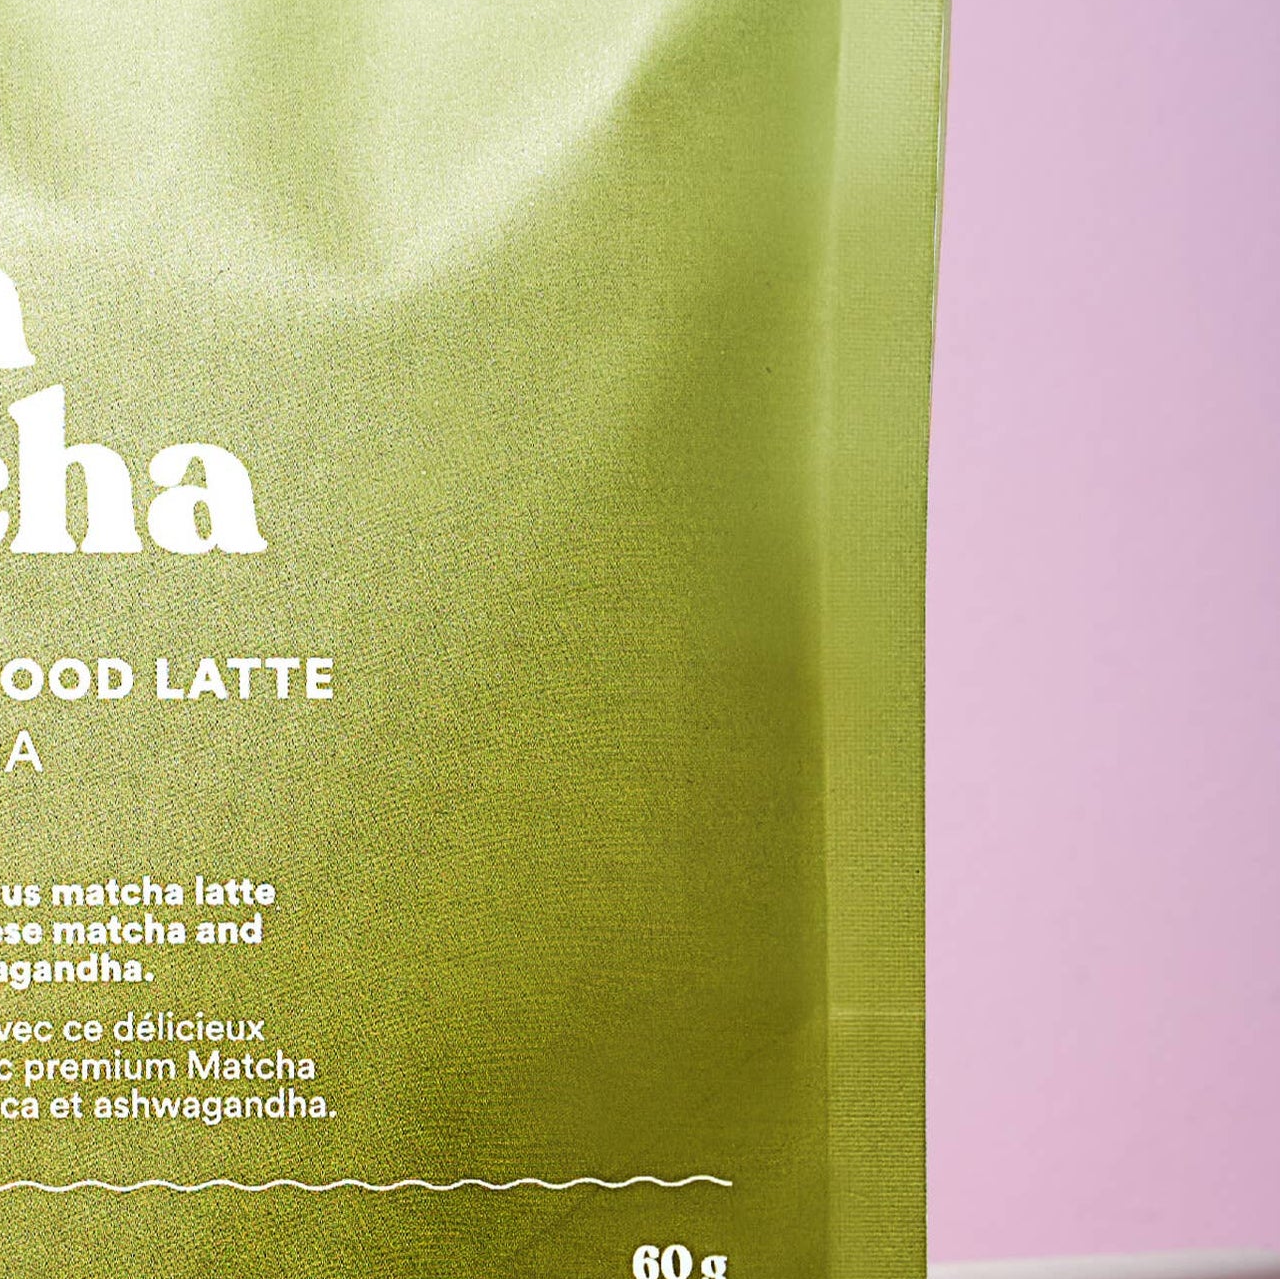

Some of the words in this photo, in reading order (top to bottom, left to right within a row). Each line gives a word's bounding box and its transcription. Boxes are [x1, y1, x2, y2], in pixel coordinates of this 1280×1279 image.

[157, 657, 334, 701] LATTE
[51, 876, 184, 906] matcha
[195, 875, 276, 905] latte
[53, 915, 185, 944] matcha
[195, 913, 263, 944] and
[63, 1019, 103, 1042] ce
[113, 1011, 264, 1042] délicieux
[25, 1050, 177, 1085] premium
[188, 1049, 316, 1080] Matcha
[50, 1091, 85, 1117] et
[95, 1087, 337, 1123] ashwagandha.
